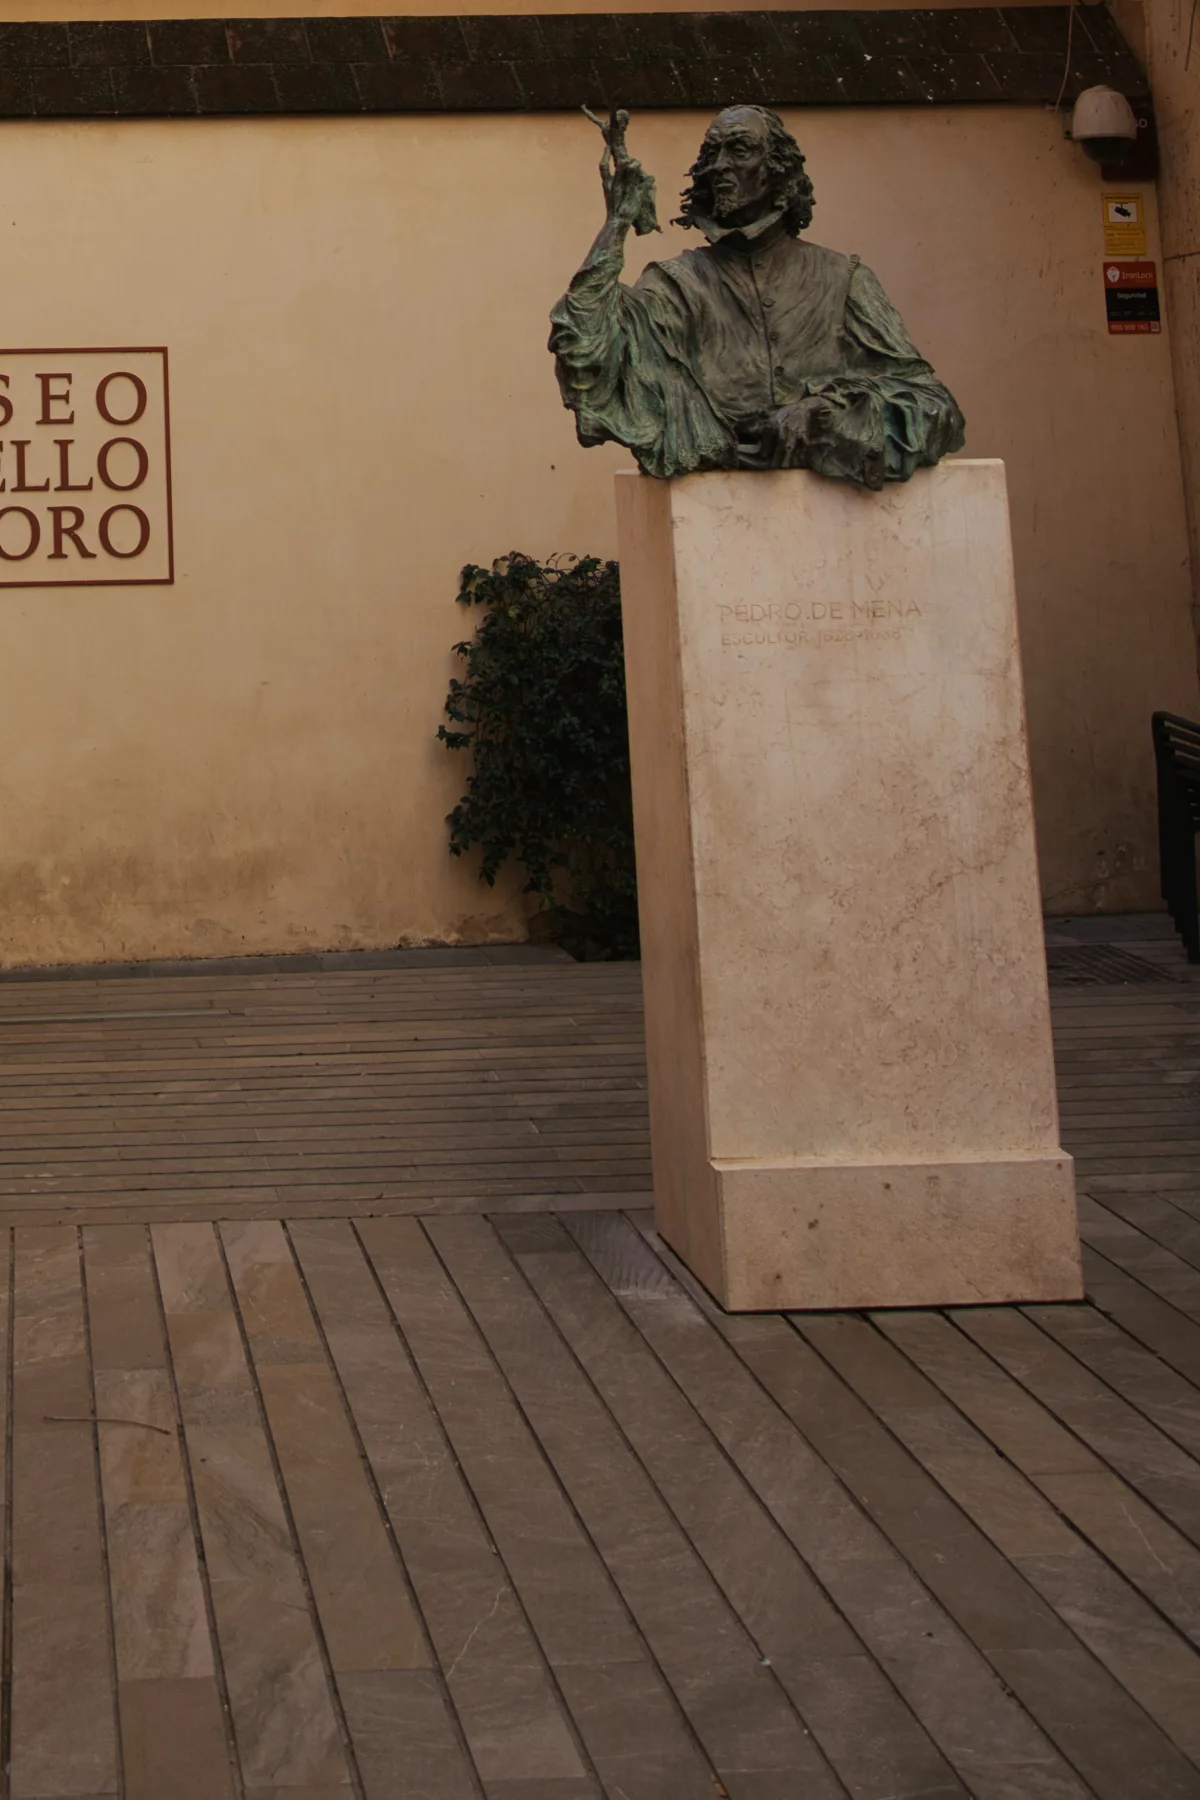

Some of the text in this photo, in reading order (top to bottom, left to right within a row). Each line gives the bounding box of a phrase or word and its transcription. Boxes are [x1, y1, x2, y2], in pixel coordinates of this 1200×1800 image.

[718, 600, 921, 622] PEDRO DE MENA
[722, 631, 808, 645] ESCULTOR
